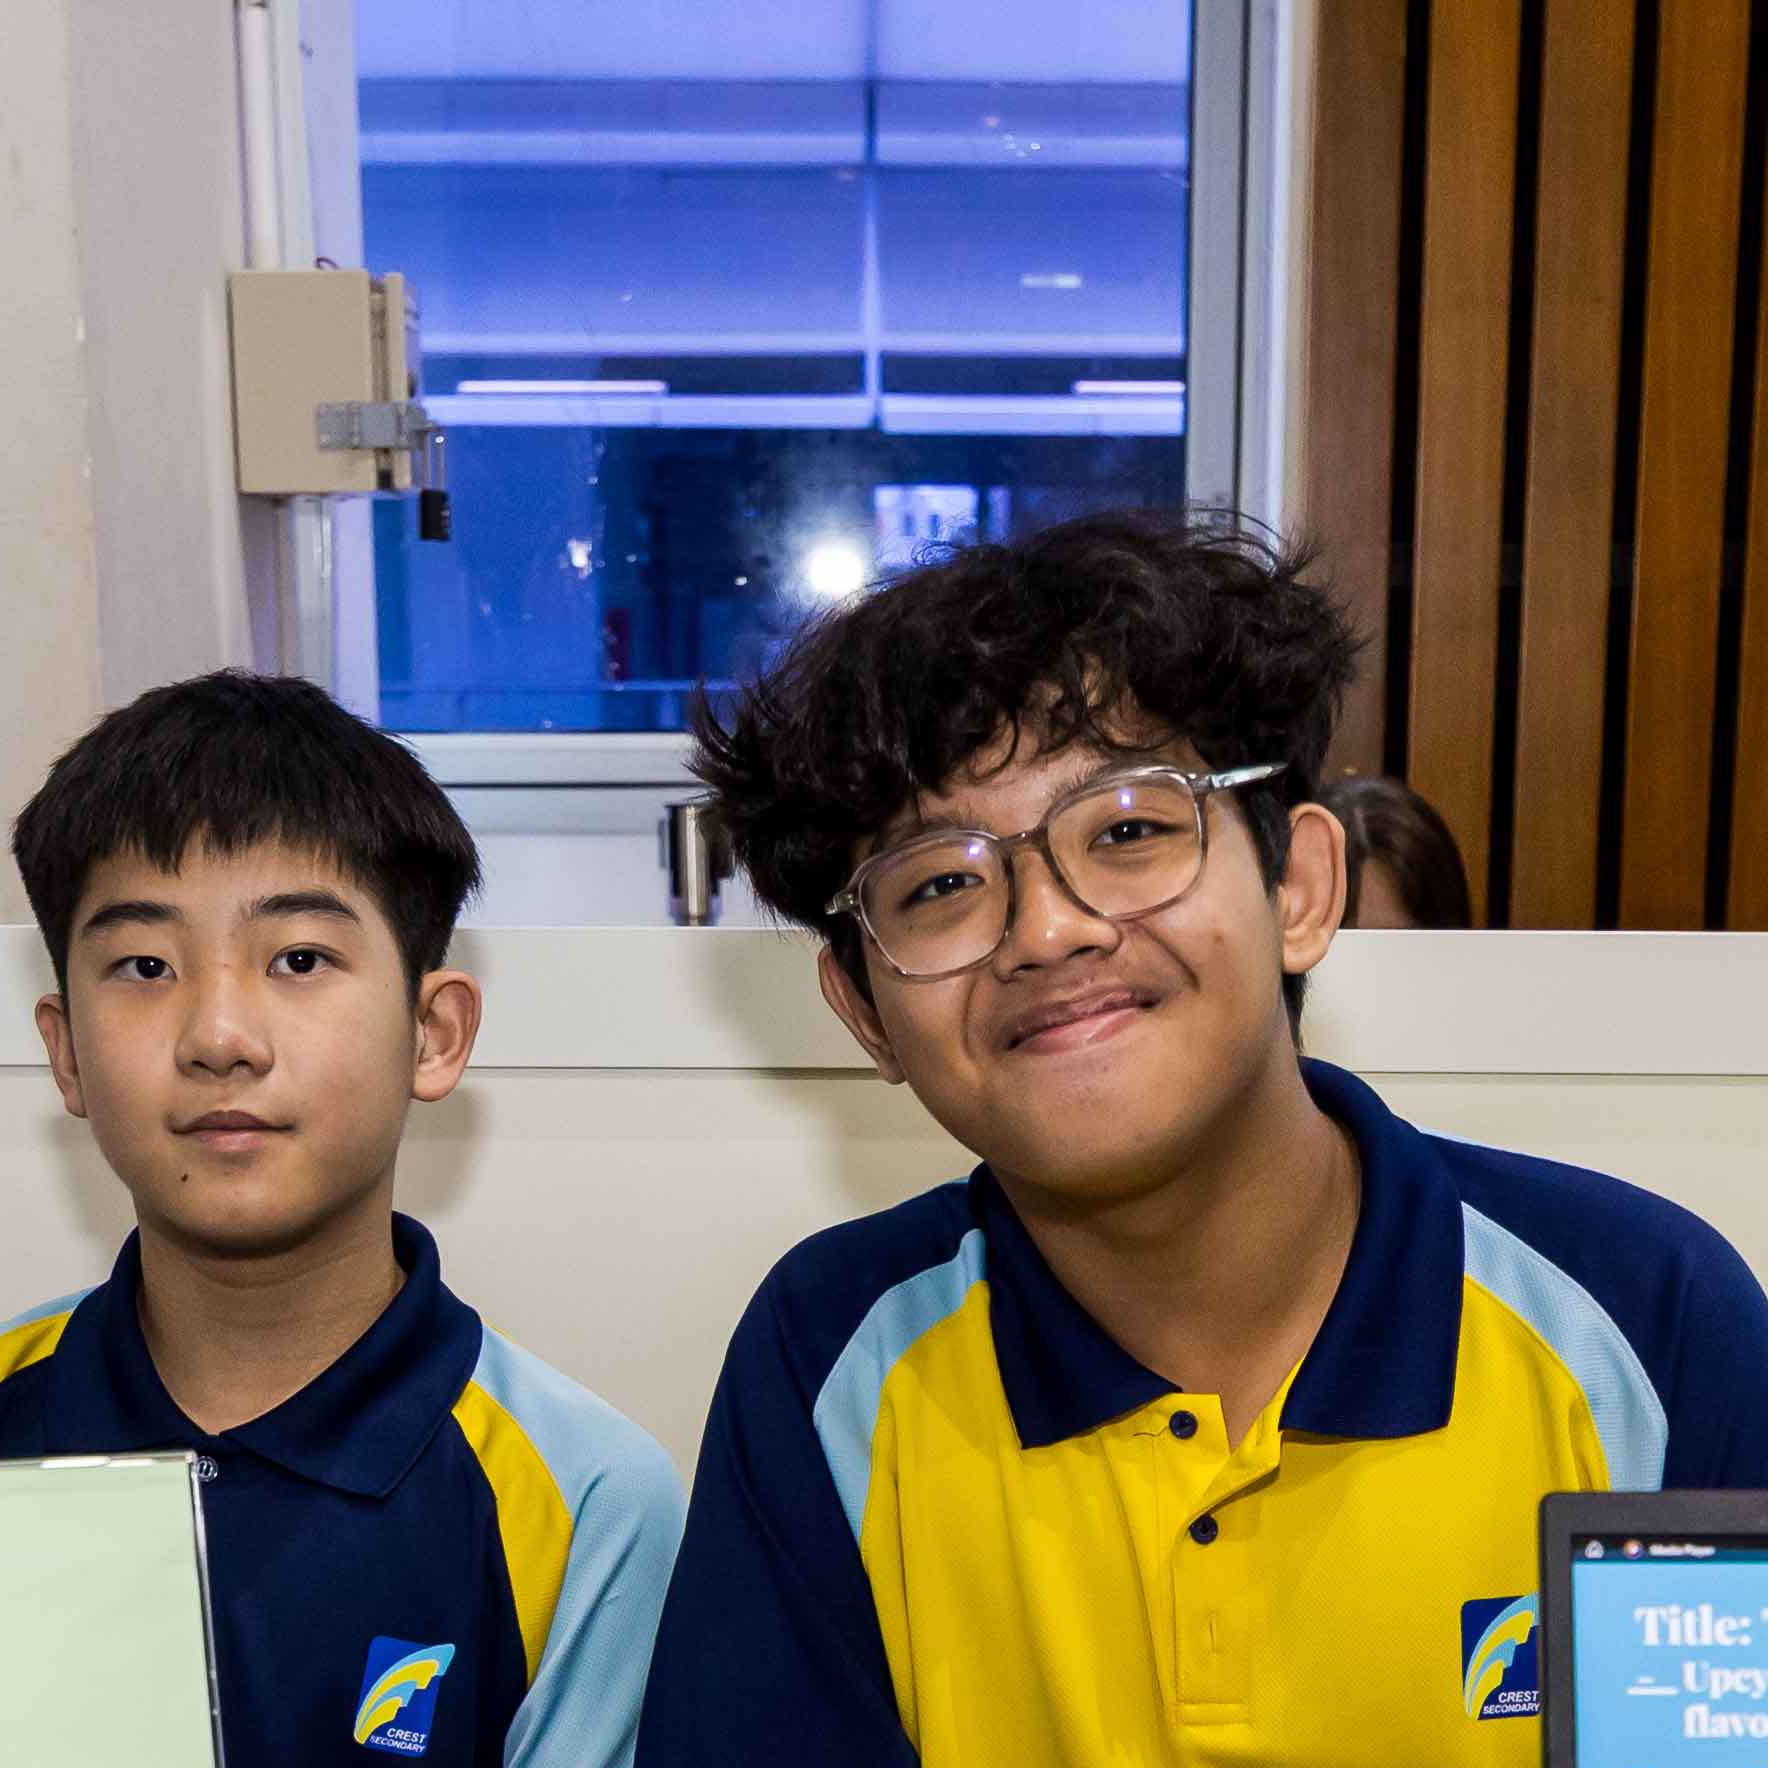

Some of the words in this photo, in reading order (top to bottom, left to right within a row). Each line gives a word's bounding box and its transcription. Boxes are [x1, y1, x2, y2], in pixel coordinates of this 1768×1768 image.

[1634, 1604, 1752, 1646] Title:
[1498, 1691, 1539, 1703] CREST
[1483, 1703, 1540, 1714] SECONDARY
[387, 1728, 426, 1743] CREST
[370, 1735, 426, 1753] SECONDARY
